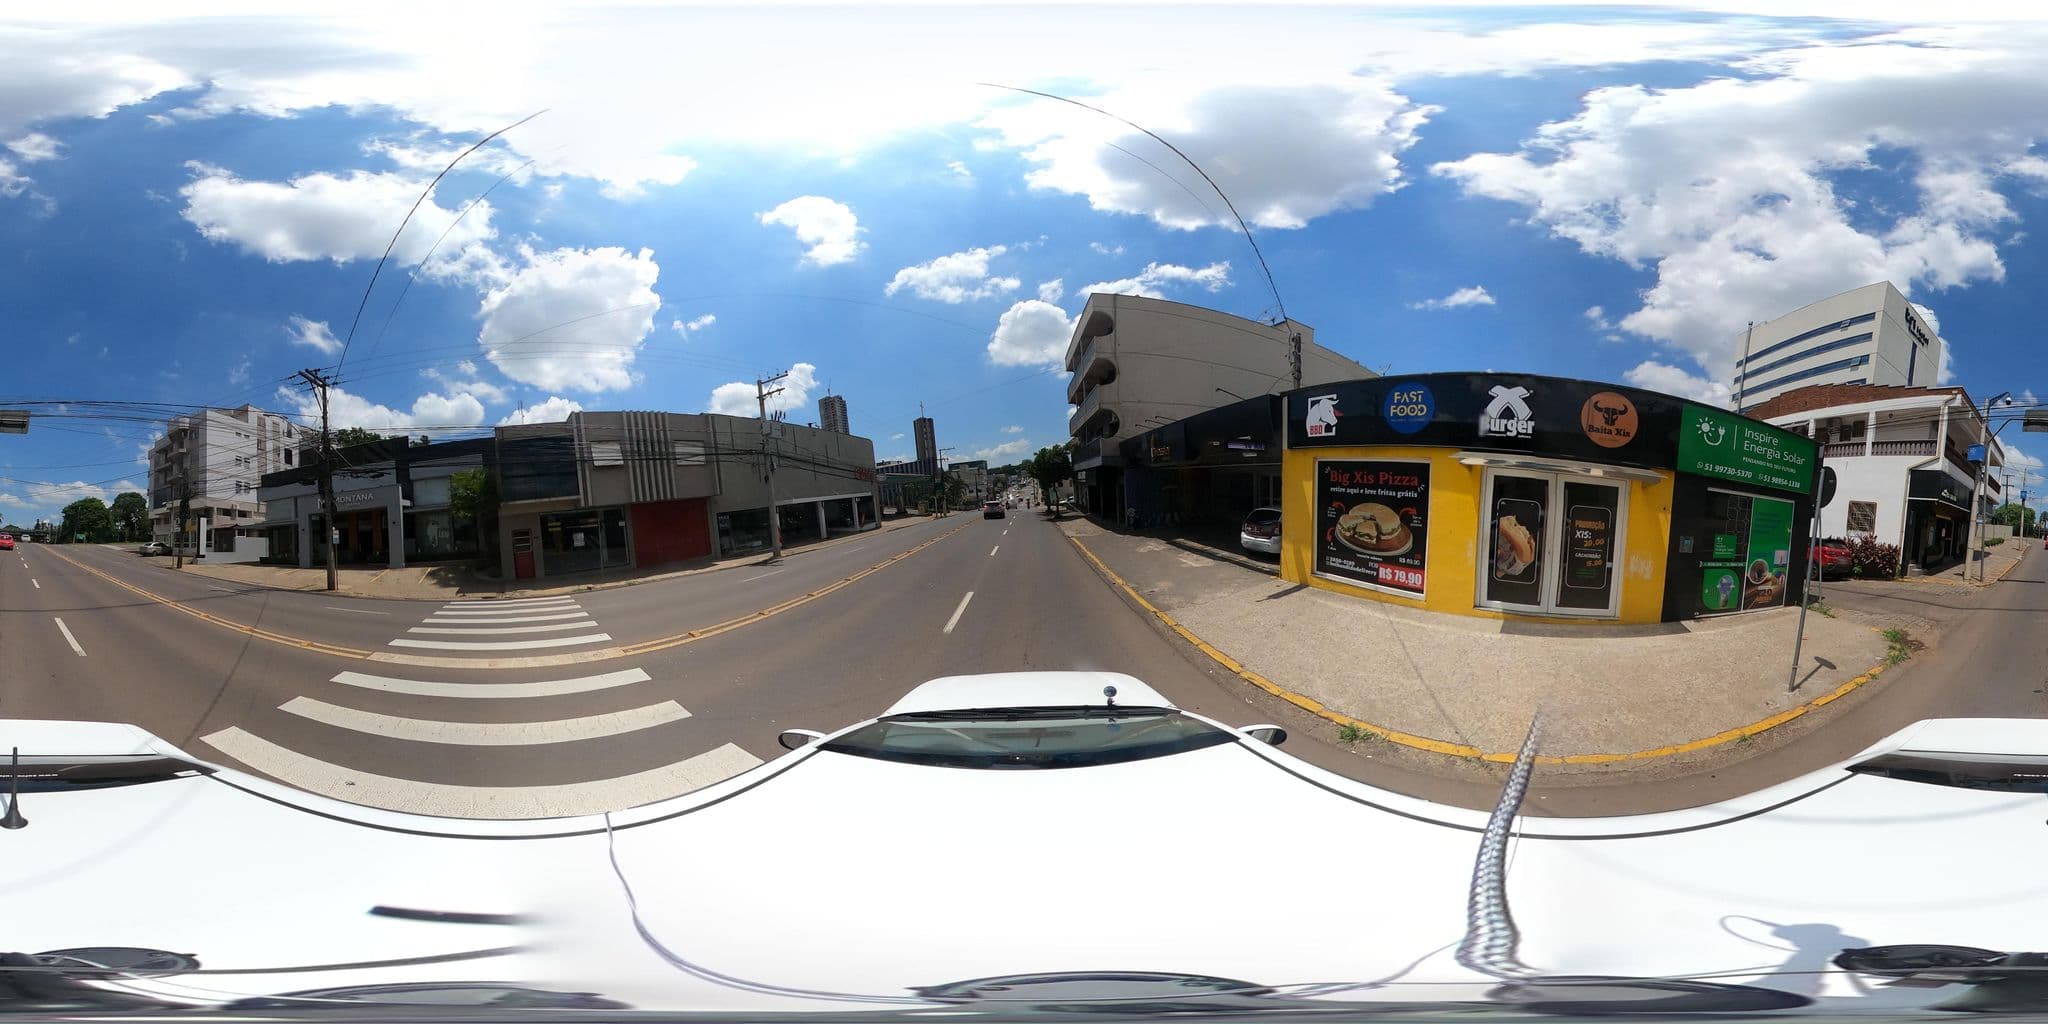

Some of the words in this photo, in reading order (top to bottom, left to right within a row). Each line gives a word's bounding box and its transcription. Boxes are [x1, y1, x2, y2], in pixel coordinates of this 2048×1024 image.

[1393, 391, 1424, 403] FAST
[1390, 404, 1427, 417] FOOD
[1588, 424, 1613, 436] Baita
[1615, 427, 1631, 438] Xis
[1744, 427, 1779, 446] Inspire
[1743, 440, 1781, 459] Energia
[1783, 451, 1806, 465] Solar
[1703, 463, 1713, 471] 51
[1714, 465, 1753, 478] 99730-5370
[1330, 470, 1350, 486] Big
[1353, 471, 1375, 484] Xis
[1379, 471, 1419, 486] Pizza
[1763, 474, 1771, 483] 51
[1364, 487, 1377, 495] leve
[1377, 488, 1396, 496] fritas
[1397, 490, 1418, 498] grátis
[1379, 567, 1392, 580] R$
[1394, 569, 1422, 585] 79,90
